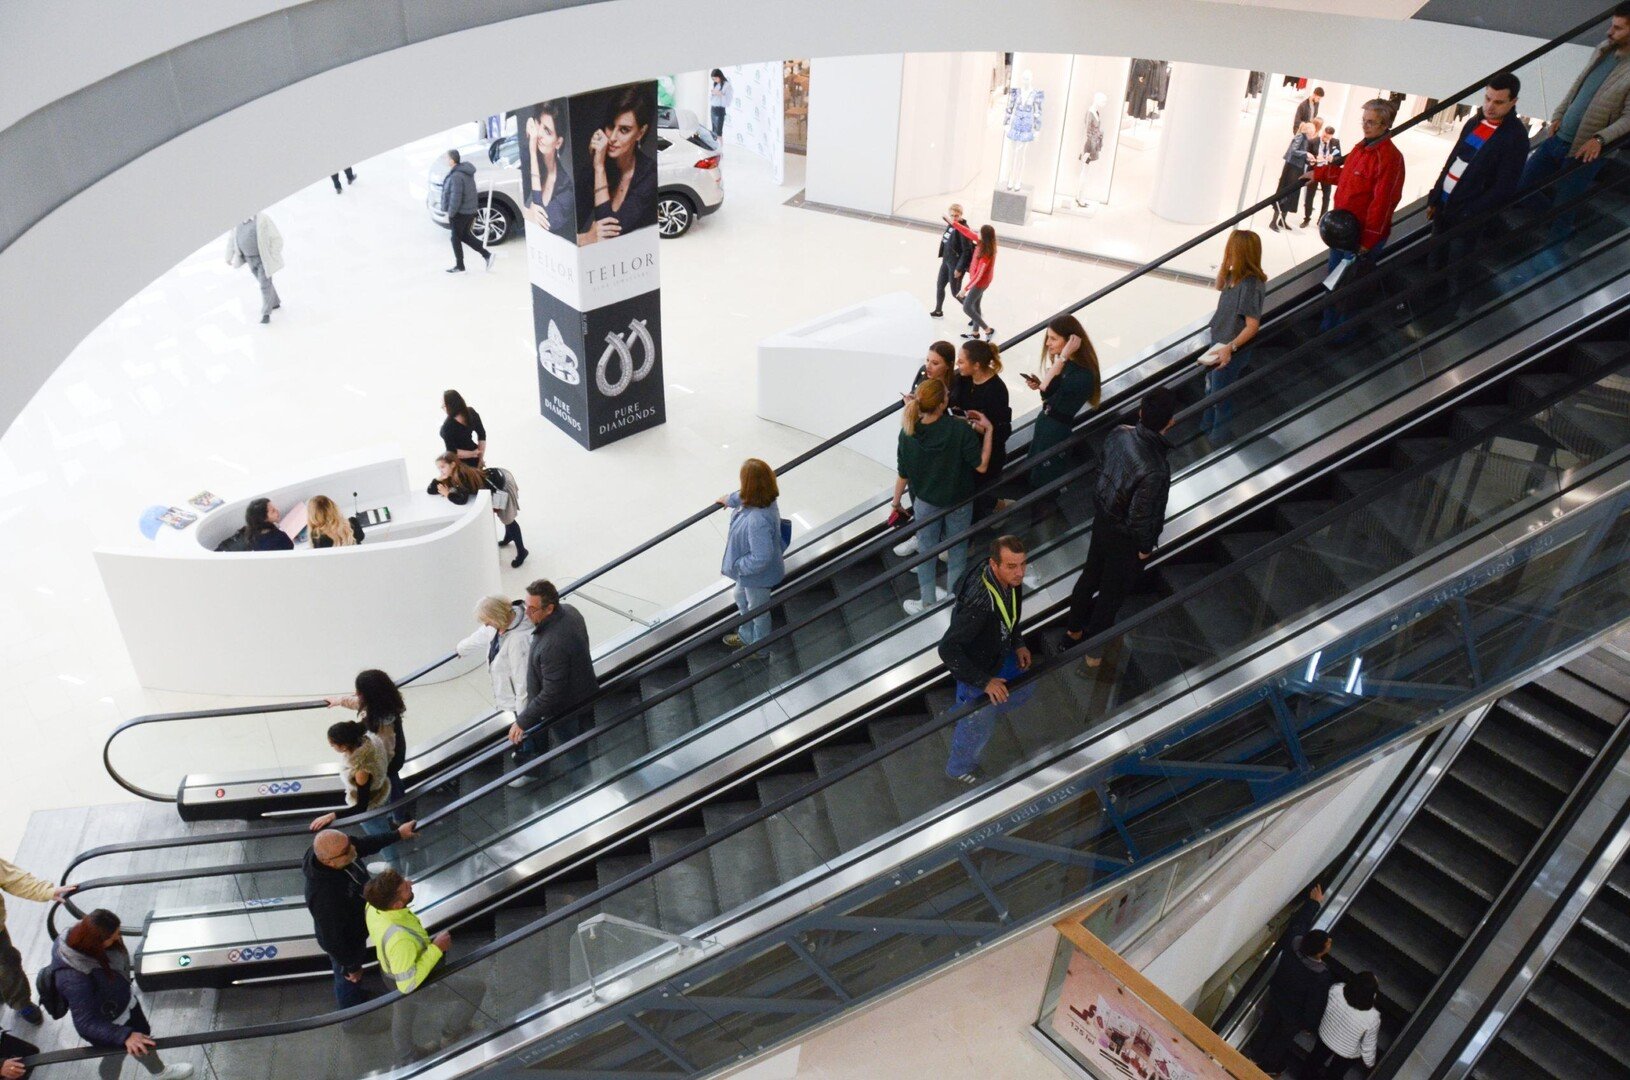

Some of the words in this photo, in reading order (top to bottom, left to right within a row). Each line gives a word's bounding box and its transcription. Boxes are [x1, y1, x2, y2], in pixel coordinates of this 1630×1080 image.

[530, 246, 574, 283] TEILOR
[587, 253, 654, 284] TEILOR
[544, 398, 582, 432] DIAMONDS
[553, 395, 571, 415] PURE
[614, 402, 640, 419] PURE
[599, 406, 656, 435] DIAMONDS
[1070, 1021, 1085, 1036] 125
